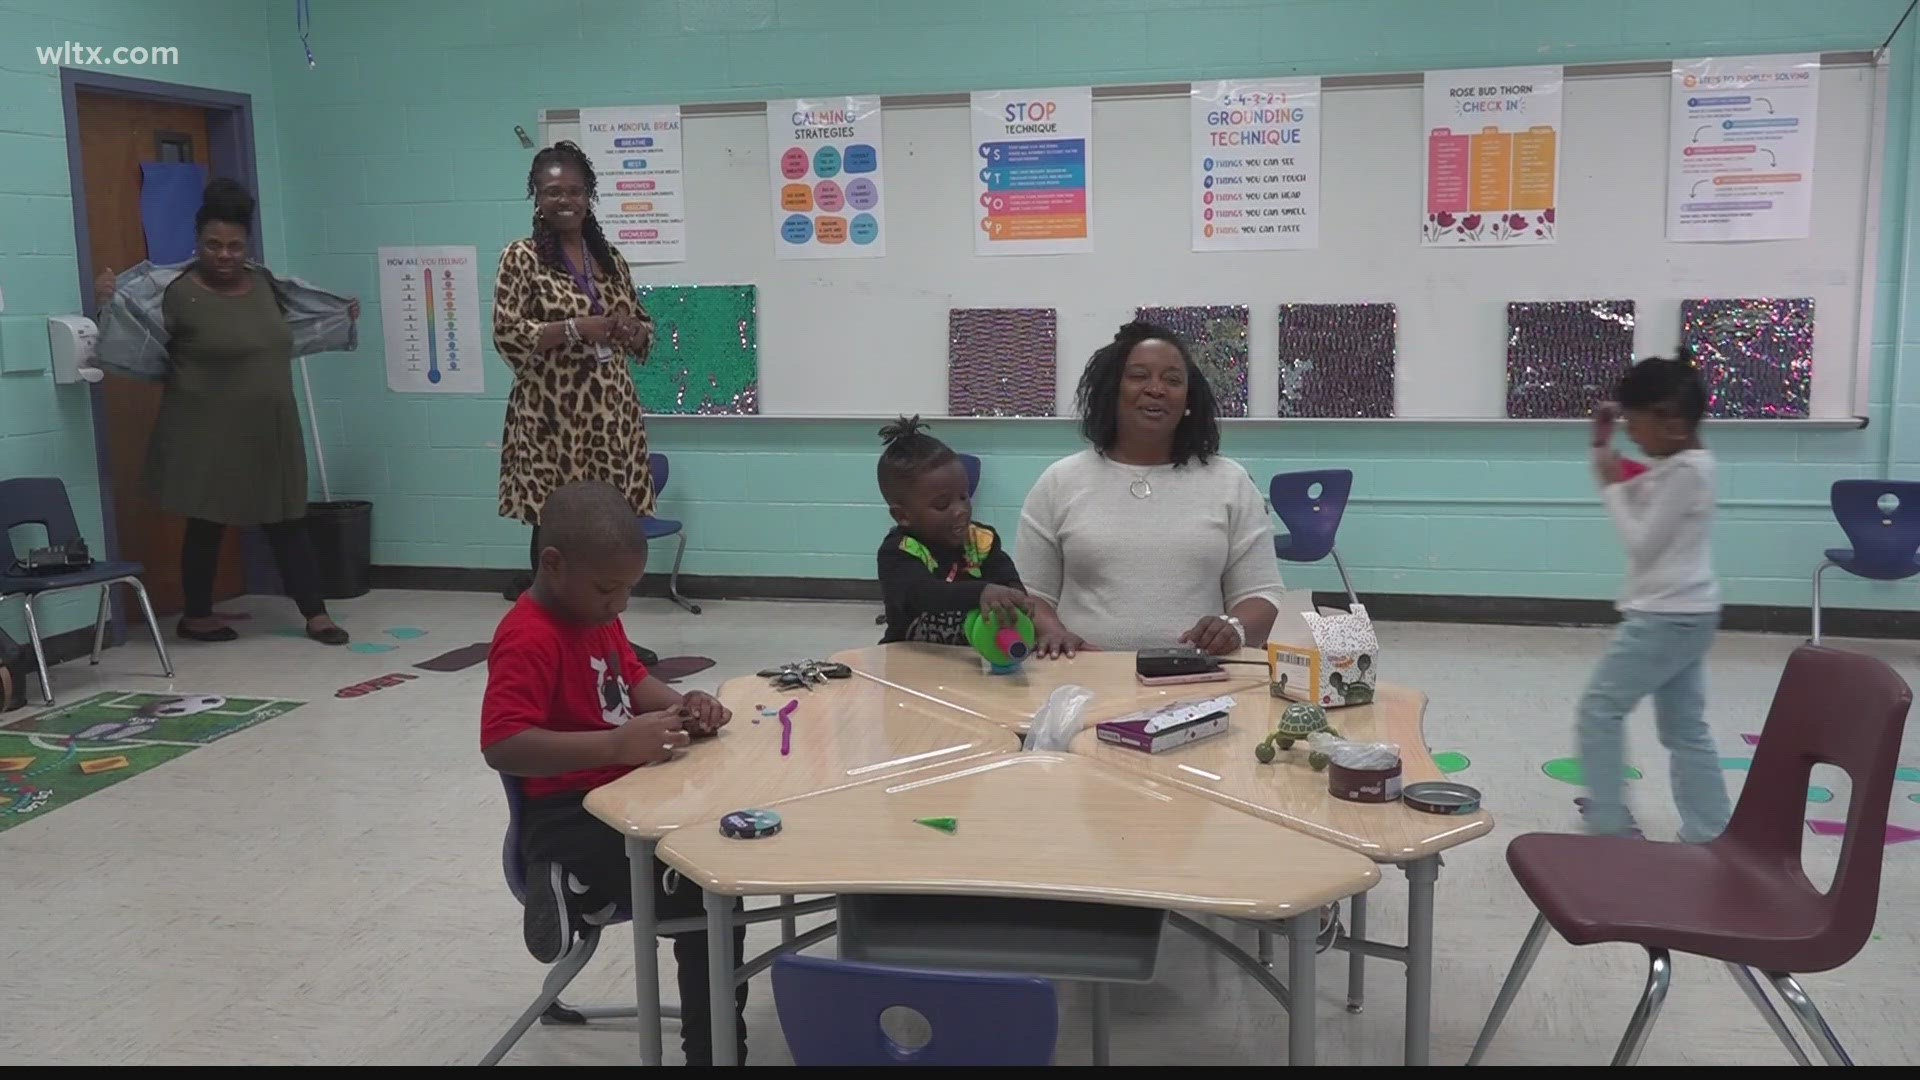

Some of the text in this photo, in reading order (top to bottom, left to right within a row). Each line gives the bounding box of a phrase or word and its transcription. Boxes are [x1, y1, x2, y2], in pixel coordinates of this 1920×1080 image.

[1775, 71, 1809, 80] SOLVING
[1450, 85, 1532, 97] ROSE BUD THORN
[1224, 93, 1287, 106] 5-4-3-2-1
[1005, 102, 1056, 122] STOP
[1462, 100, 1518, 113] CHECK IN
[792, 110, 856, 126] CALMING
[1208, 108, 1304, 125] GROUNDING
[589, 121, 679, 133] TAKE A MINDFUL BREAK
[795, 127, 854, 139] STRATEGIES
[1005, 123, 1057, 135] TECHNIQUE
[1210, 129, 1301, 146] TECHNIQUE
[993, 149, 1000, 161] S
[1216, 159, 1243, 168] THINGS
[1263, 158, 1278, 166] CAN
[994, 173, 1001, 184] T
[1216, 176, 1242, 185] THINGS
[1263, 175, 1278, 183] CAN
[1282, 174, 1306, 182] TOUCH
[1216, 192, 1242, 201] THINGS
[1263, 192, 1278, 200] CAN
[1281, 191, 1301, 199] HEAR
[993, 198, 1003, 210] O
[1245, 209, 1260, 217] YOU
[1263, 208, 1278, 216] CAN
[1281, 207, 1306, 215] SMELL
[996, 223, 1002, 234] P
[1216, 226, 1239, 234] THING
[1241, 226, 1256, 234] YOU
[1259, 225, 1274, 233] CAN
[1278, 224, 1300, 232] TASTE
[387, 258, 403, 266] HOW
[405, 258, 417, 266] ARE
